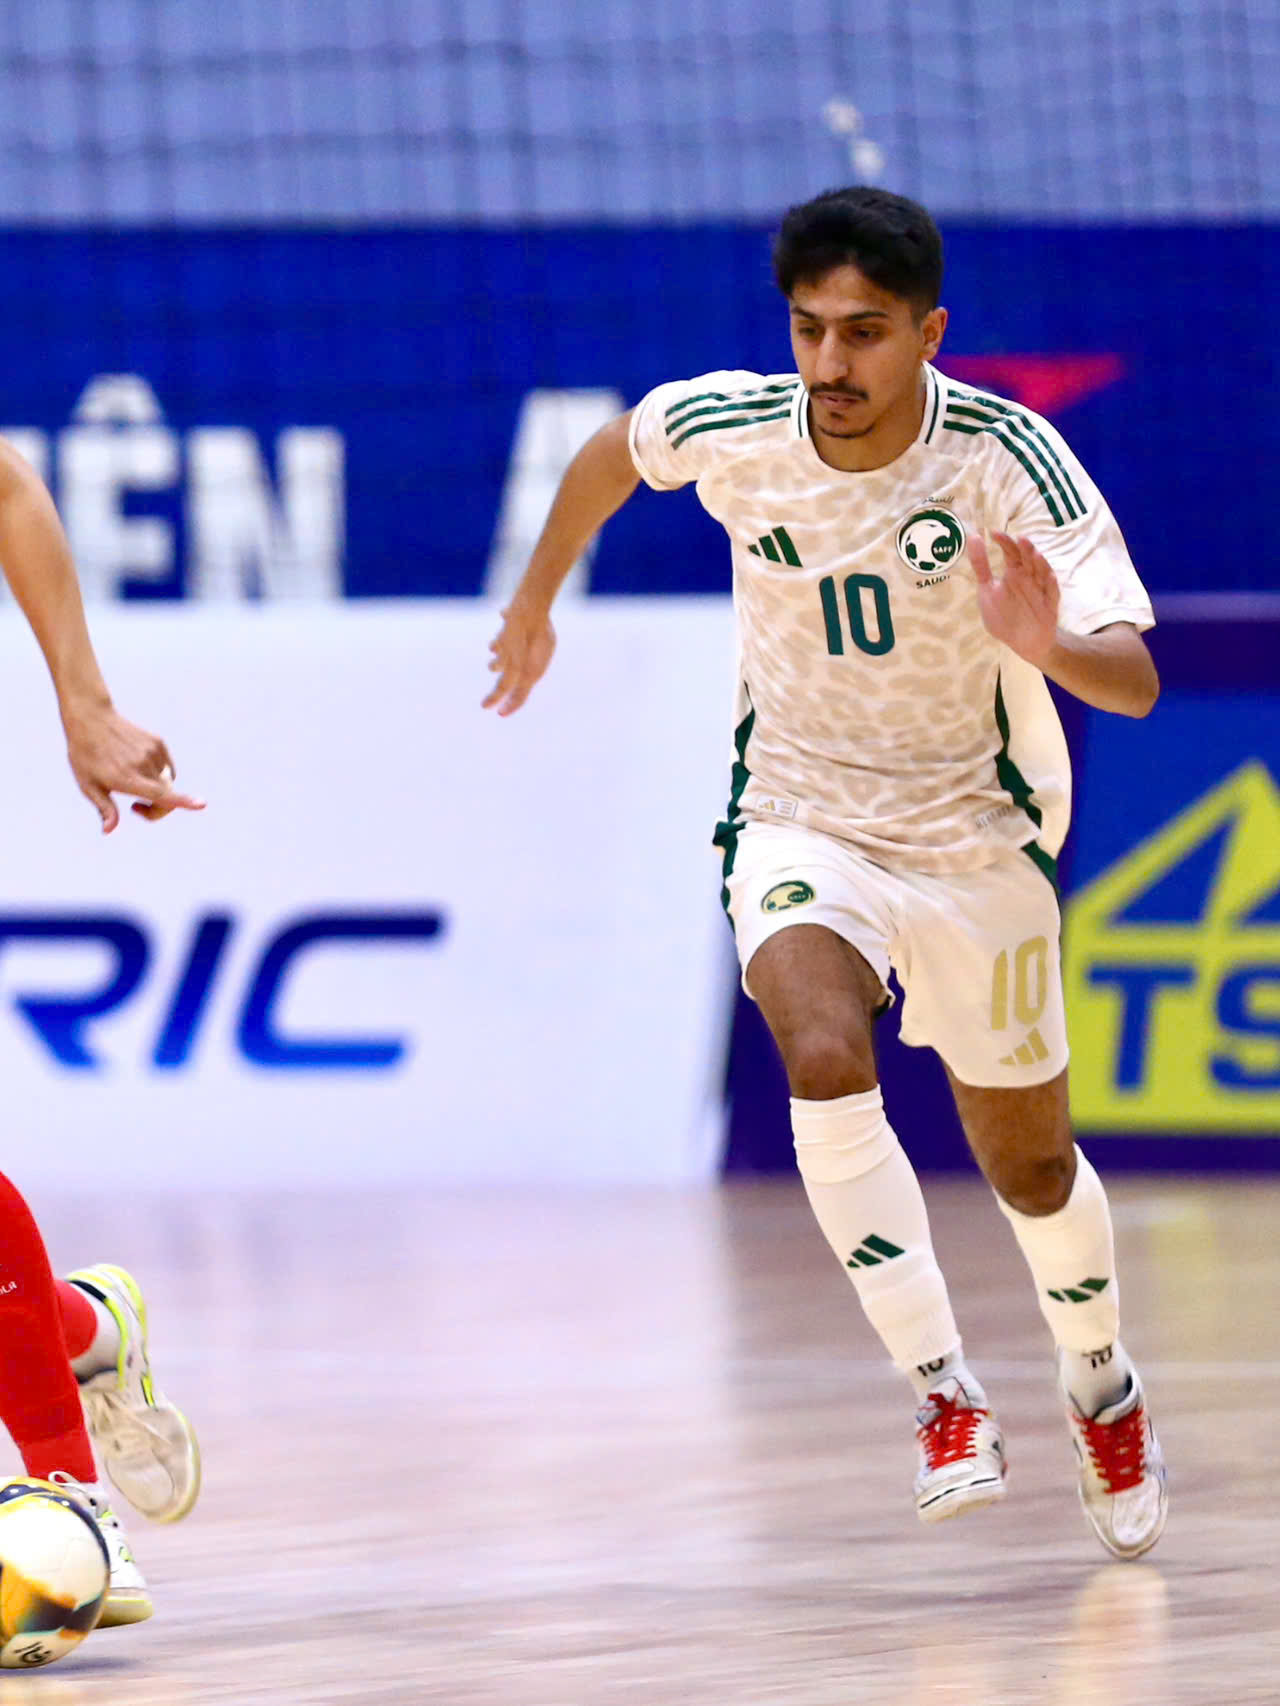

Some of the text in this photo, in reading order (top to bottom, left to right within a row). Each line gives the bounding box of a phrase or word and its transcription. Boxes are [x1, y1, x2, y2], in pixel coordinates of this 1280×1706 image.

[932, 545, 953, 554] SAFF
[818, 573, 895, 656] 10
[991, 935, 1049, 1031] 10
